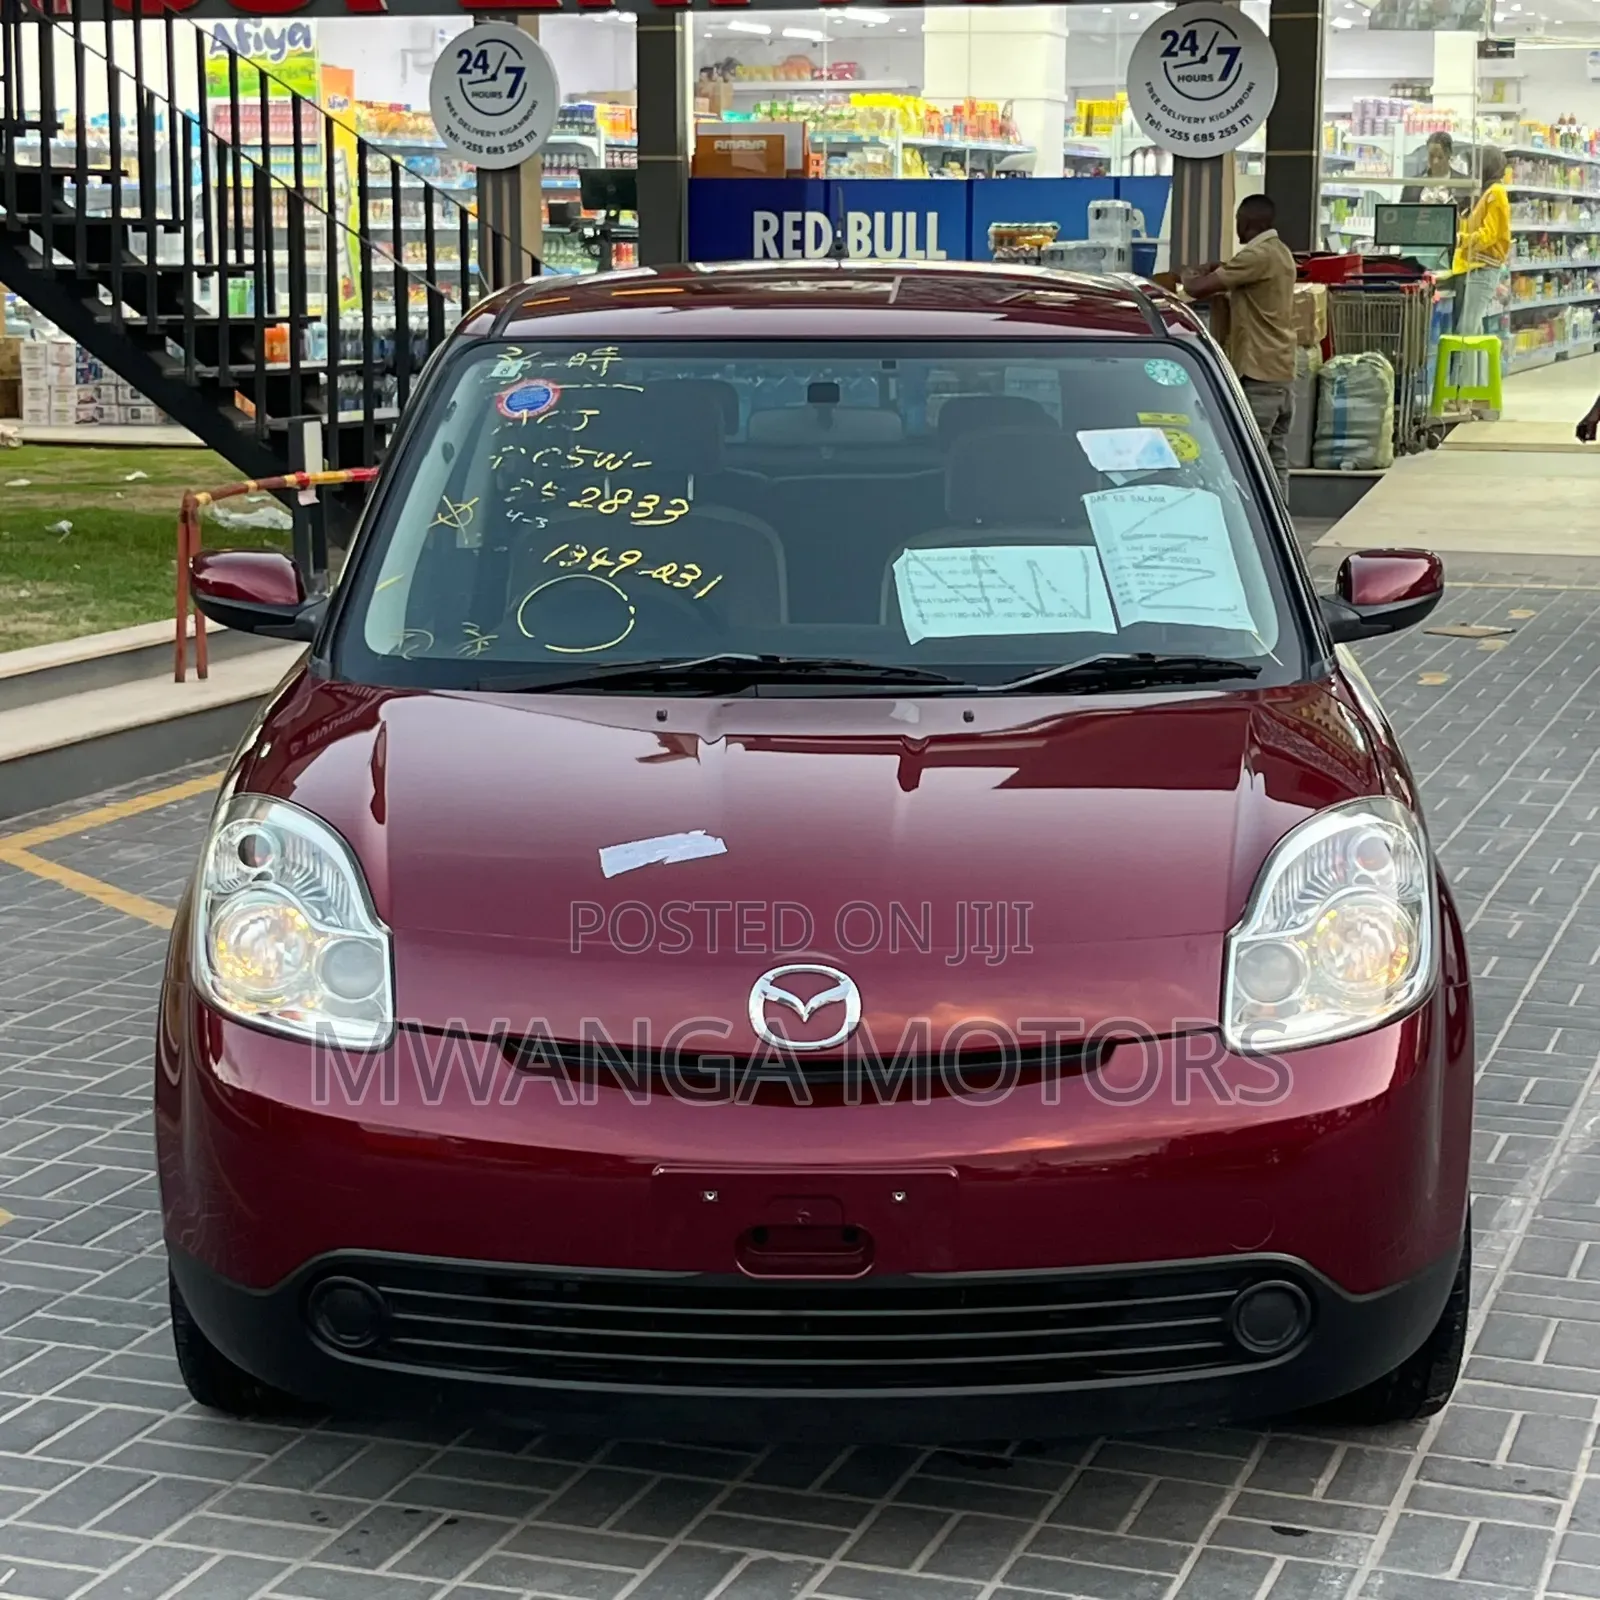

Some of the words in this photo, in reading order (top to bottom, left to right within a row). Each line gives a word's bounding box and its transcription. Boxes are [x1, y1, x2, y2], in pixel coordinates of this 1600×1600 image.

[209, 17, 312, 62] Afiya
[1160, 29, 1199, 58] 24
[1216, 46, 1242, 82] 7
[456, 48, 490, 75] 24
[504, 66, 526, 99] 7
[1177, 74, 1214, 83] HOURS
[471, 91, 503, 99] HOURS
[1145, 81, 1161, 106] FREE
[1160, 104, 1206, 124] DELIVERY
[1209, 81, 1256, 123] KIGAMBONI
[444, 96, 458, 118] FREE
[457, 117, 497, 138] DELIVERY
[499, 100, 539, 137] KIGAMBONI
[1144, 112, 1163, 131] Tel:
[1164, 127, 1190, 142] +255
[1193, 132, 1215, 143] 685
[1218, 124, 1238, 139] 255
[444, 124, 460, 144] Tel:
[461, 140, 484, 154] +255
[486, 145, 505, 155] 685
[507, 137, 525, 152] 255
[753, 211, 833, 259] RED
[847, 211, 947, 260] BULL
